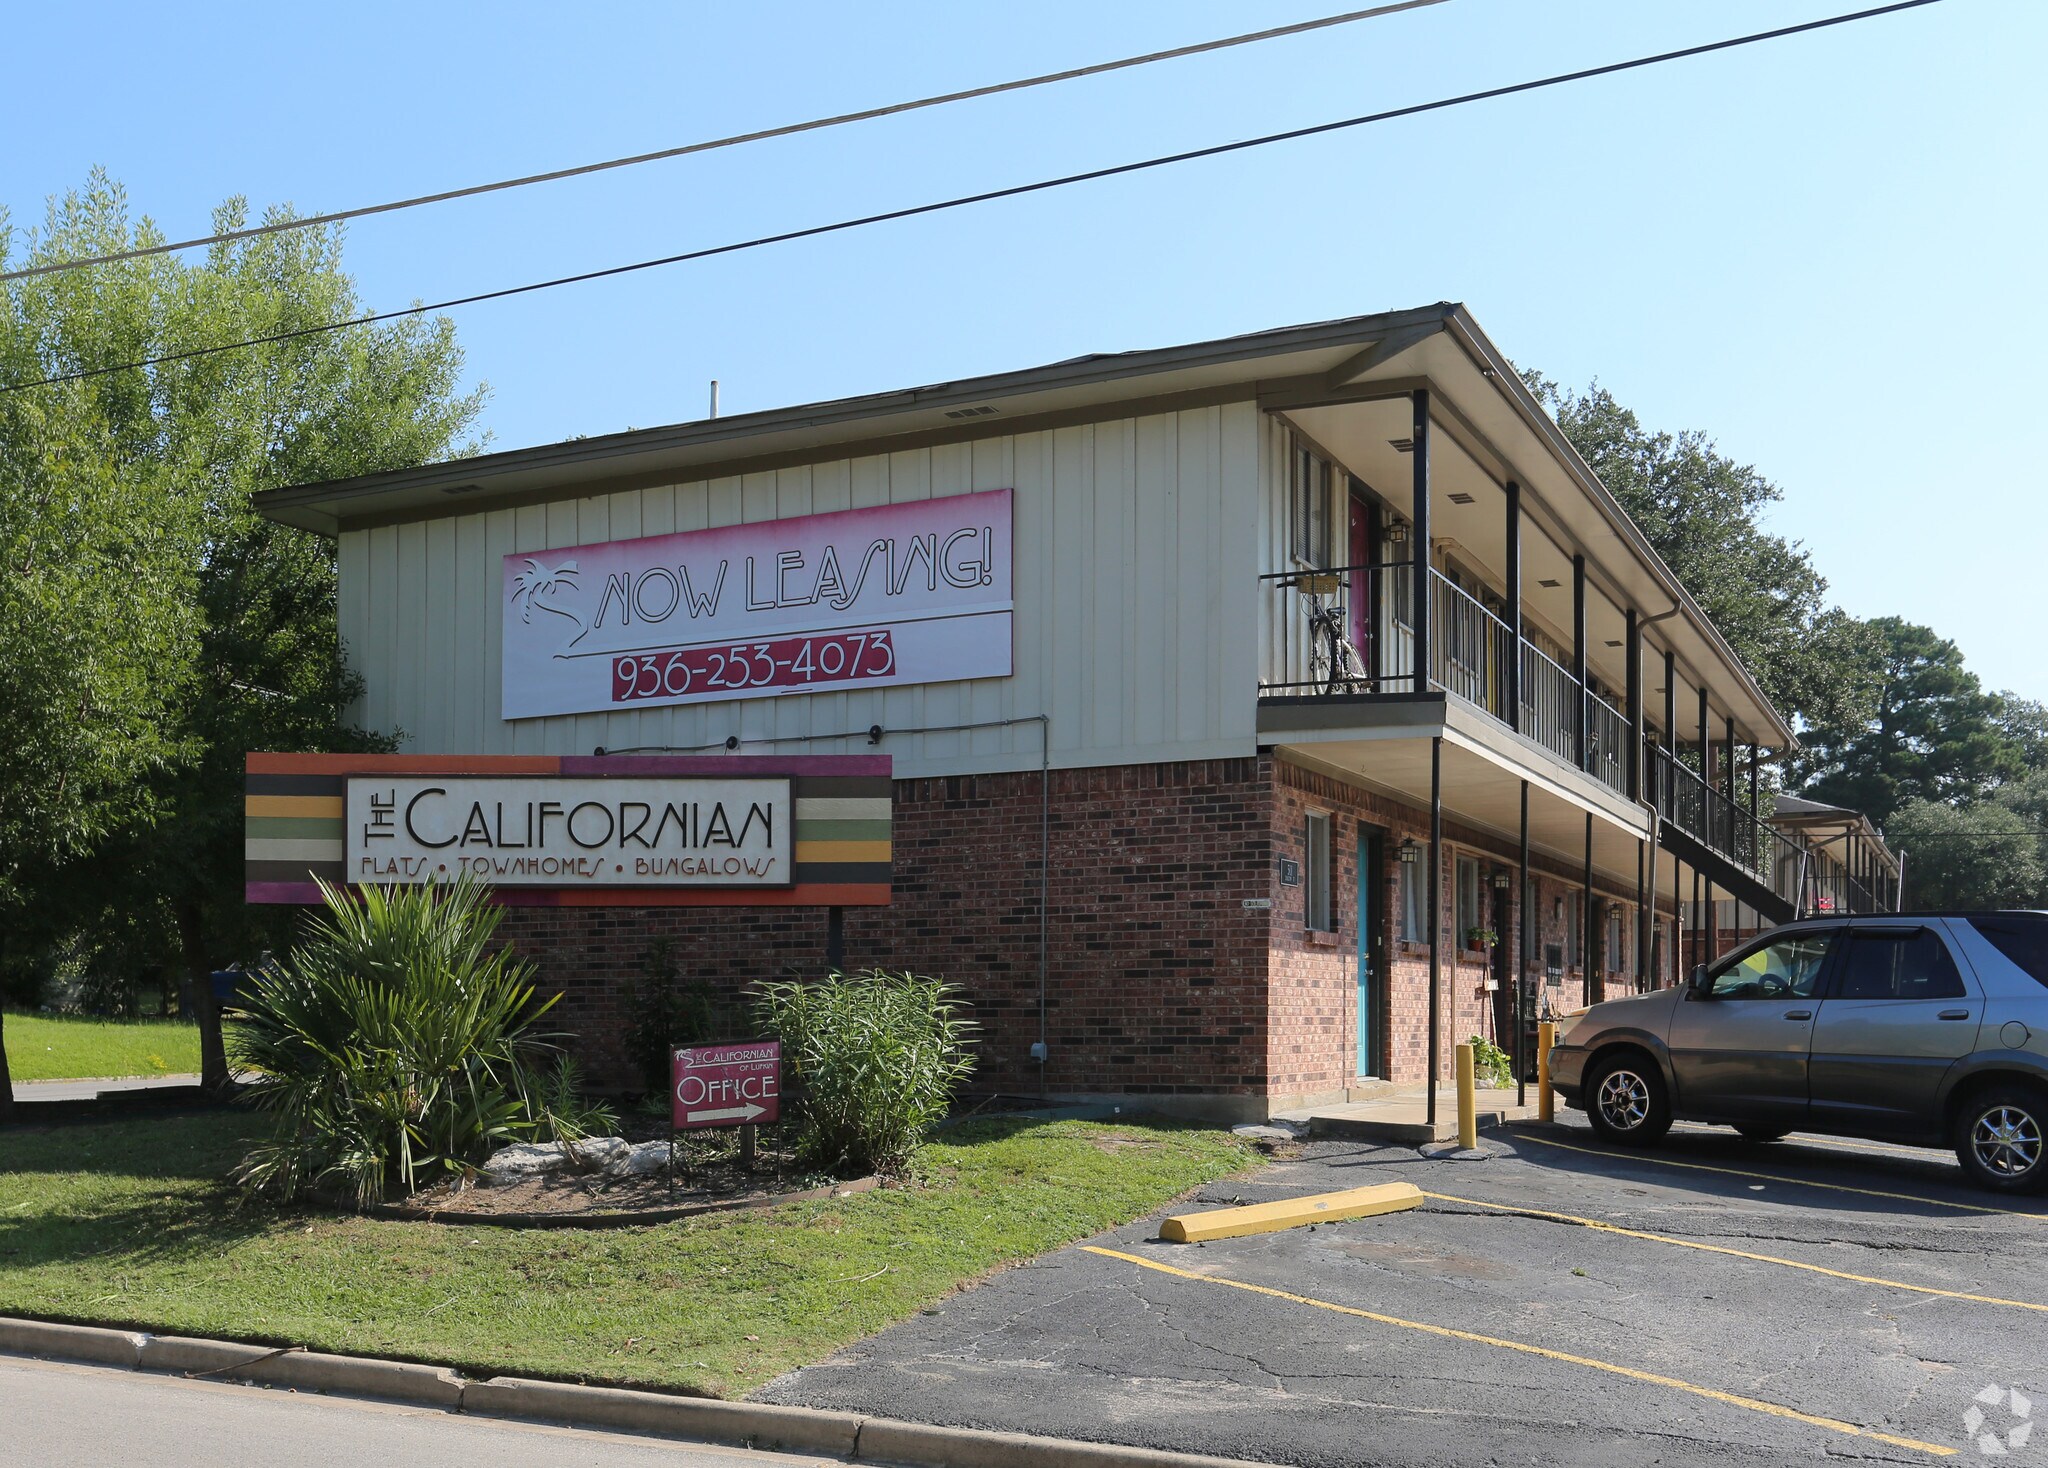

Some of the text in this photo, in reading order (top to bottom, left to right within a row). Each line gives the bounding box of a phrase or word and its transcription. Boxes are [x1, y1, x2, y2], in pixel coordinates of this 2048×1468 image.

[594, 526, 992, 628] NOW LEASING!
[617, 630, 895, 699] 936-253-4073
[364, 787, 773, 849] THE CALIFORNIAN
[361, 856, 776, 878] FLATS TOWNHOMES BUNGALOWS
[703, 1049, 773, 1063] CALIFORNIAN
[677, 1076, 779, 1105] OFFICE
